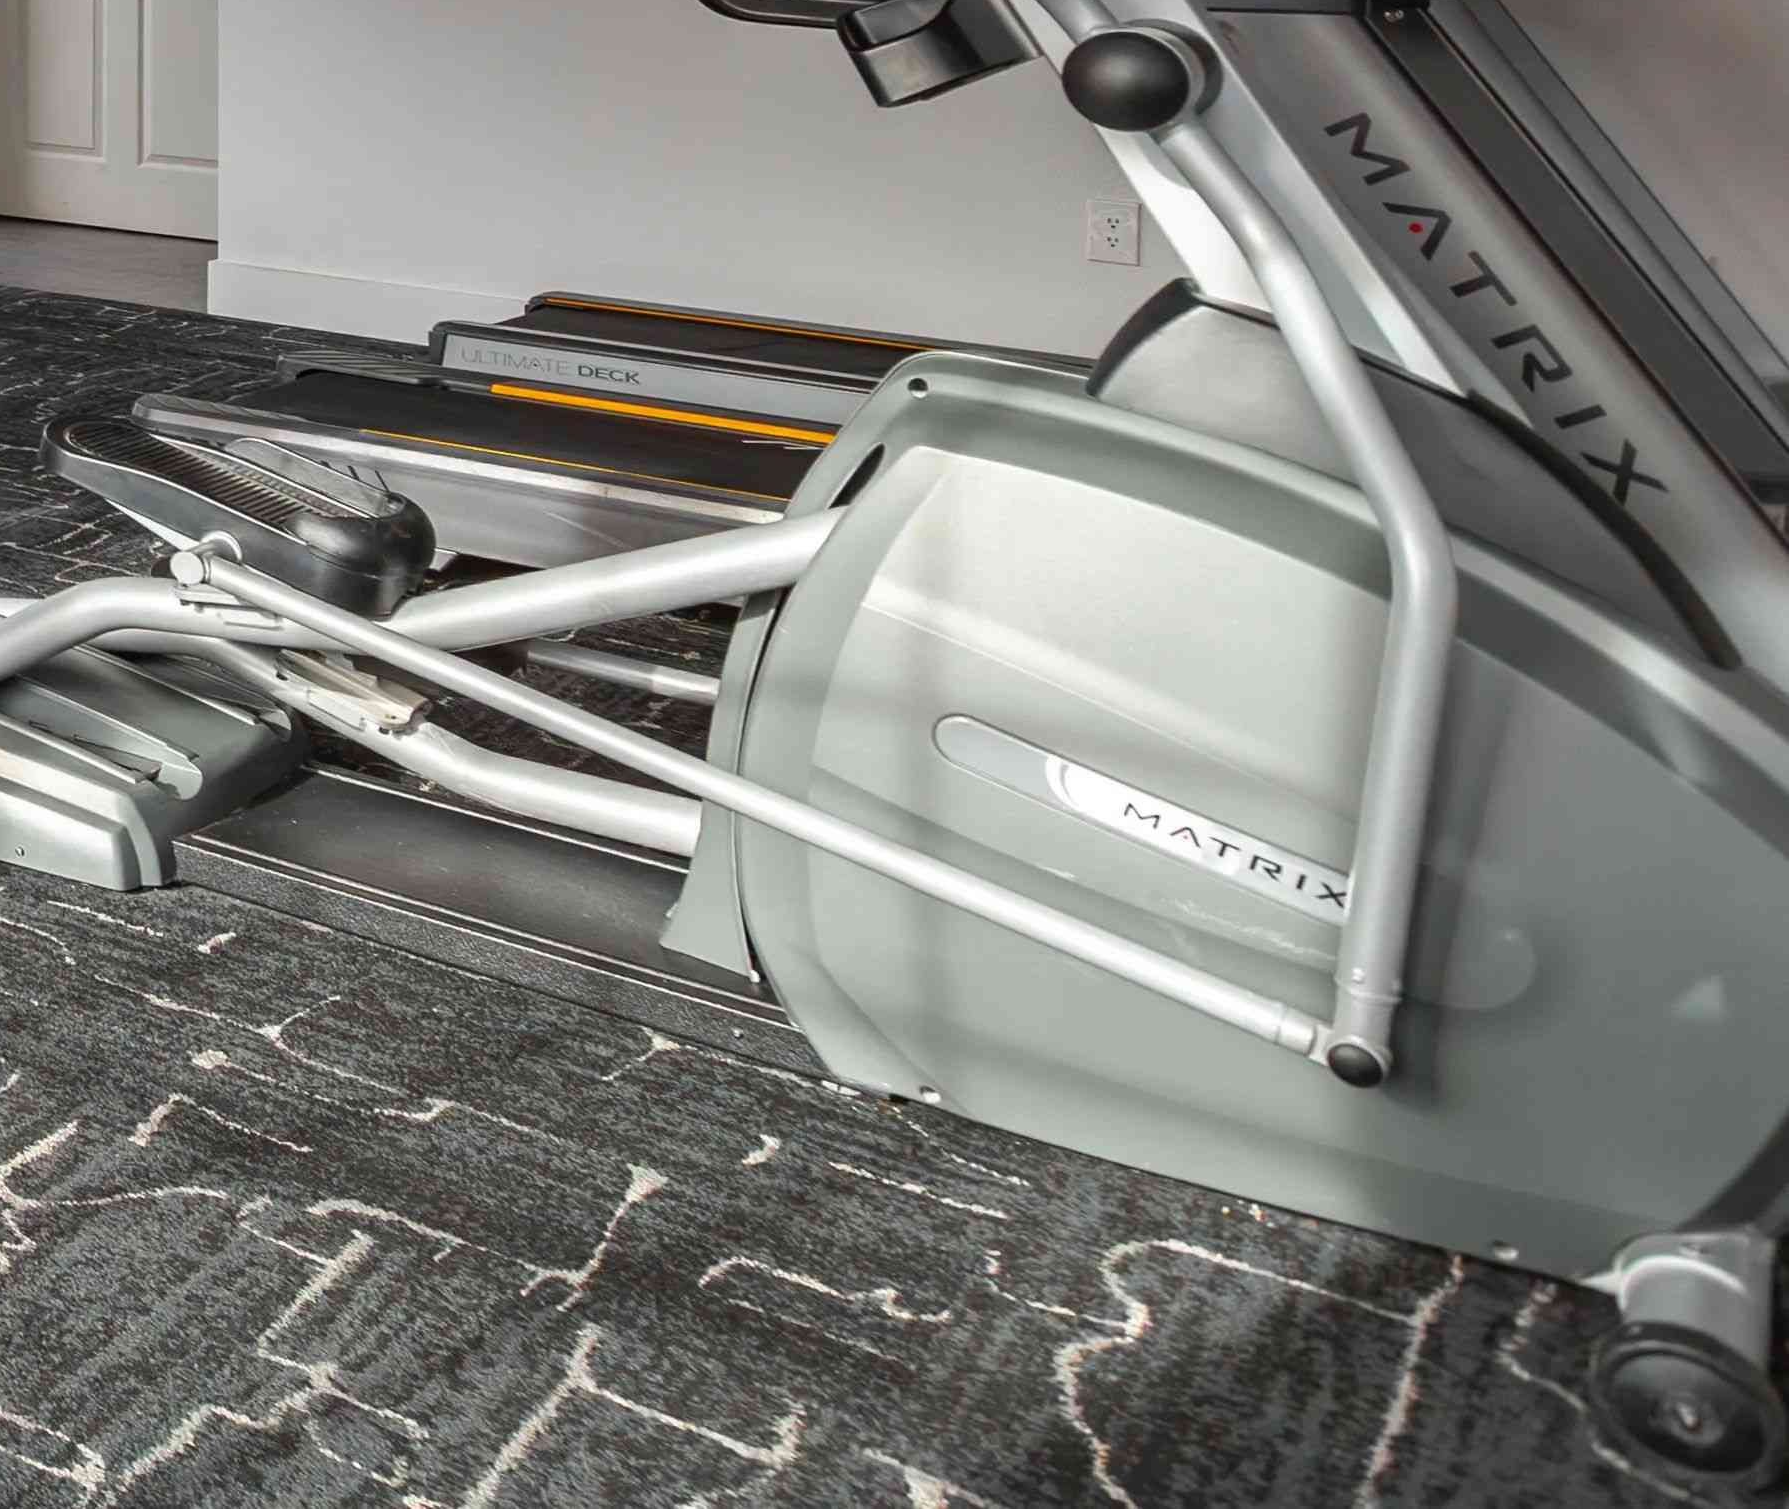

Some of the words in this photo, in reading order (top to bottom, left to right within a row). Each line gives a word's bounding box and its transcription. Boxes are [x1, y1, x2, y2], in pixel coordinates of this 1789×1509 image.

[1324, 111, 1670, 507] MATRIX
[460, 347, 570, 377] ULTIMATE
[577, 365, 639, 386] DECK
[1123, 802, 1346, 907] MATRIX
